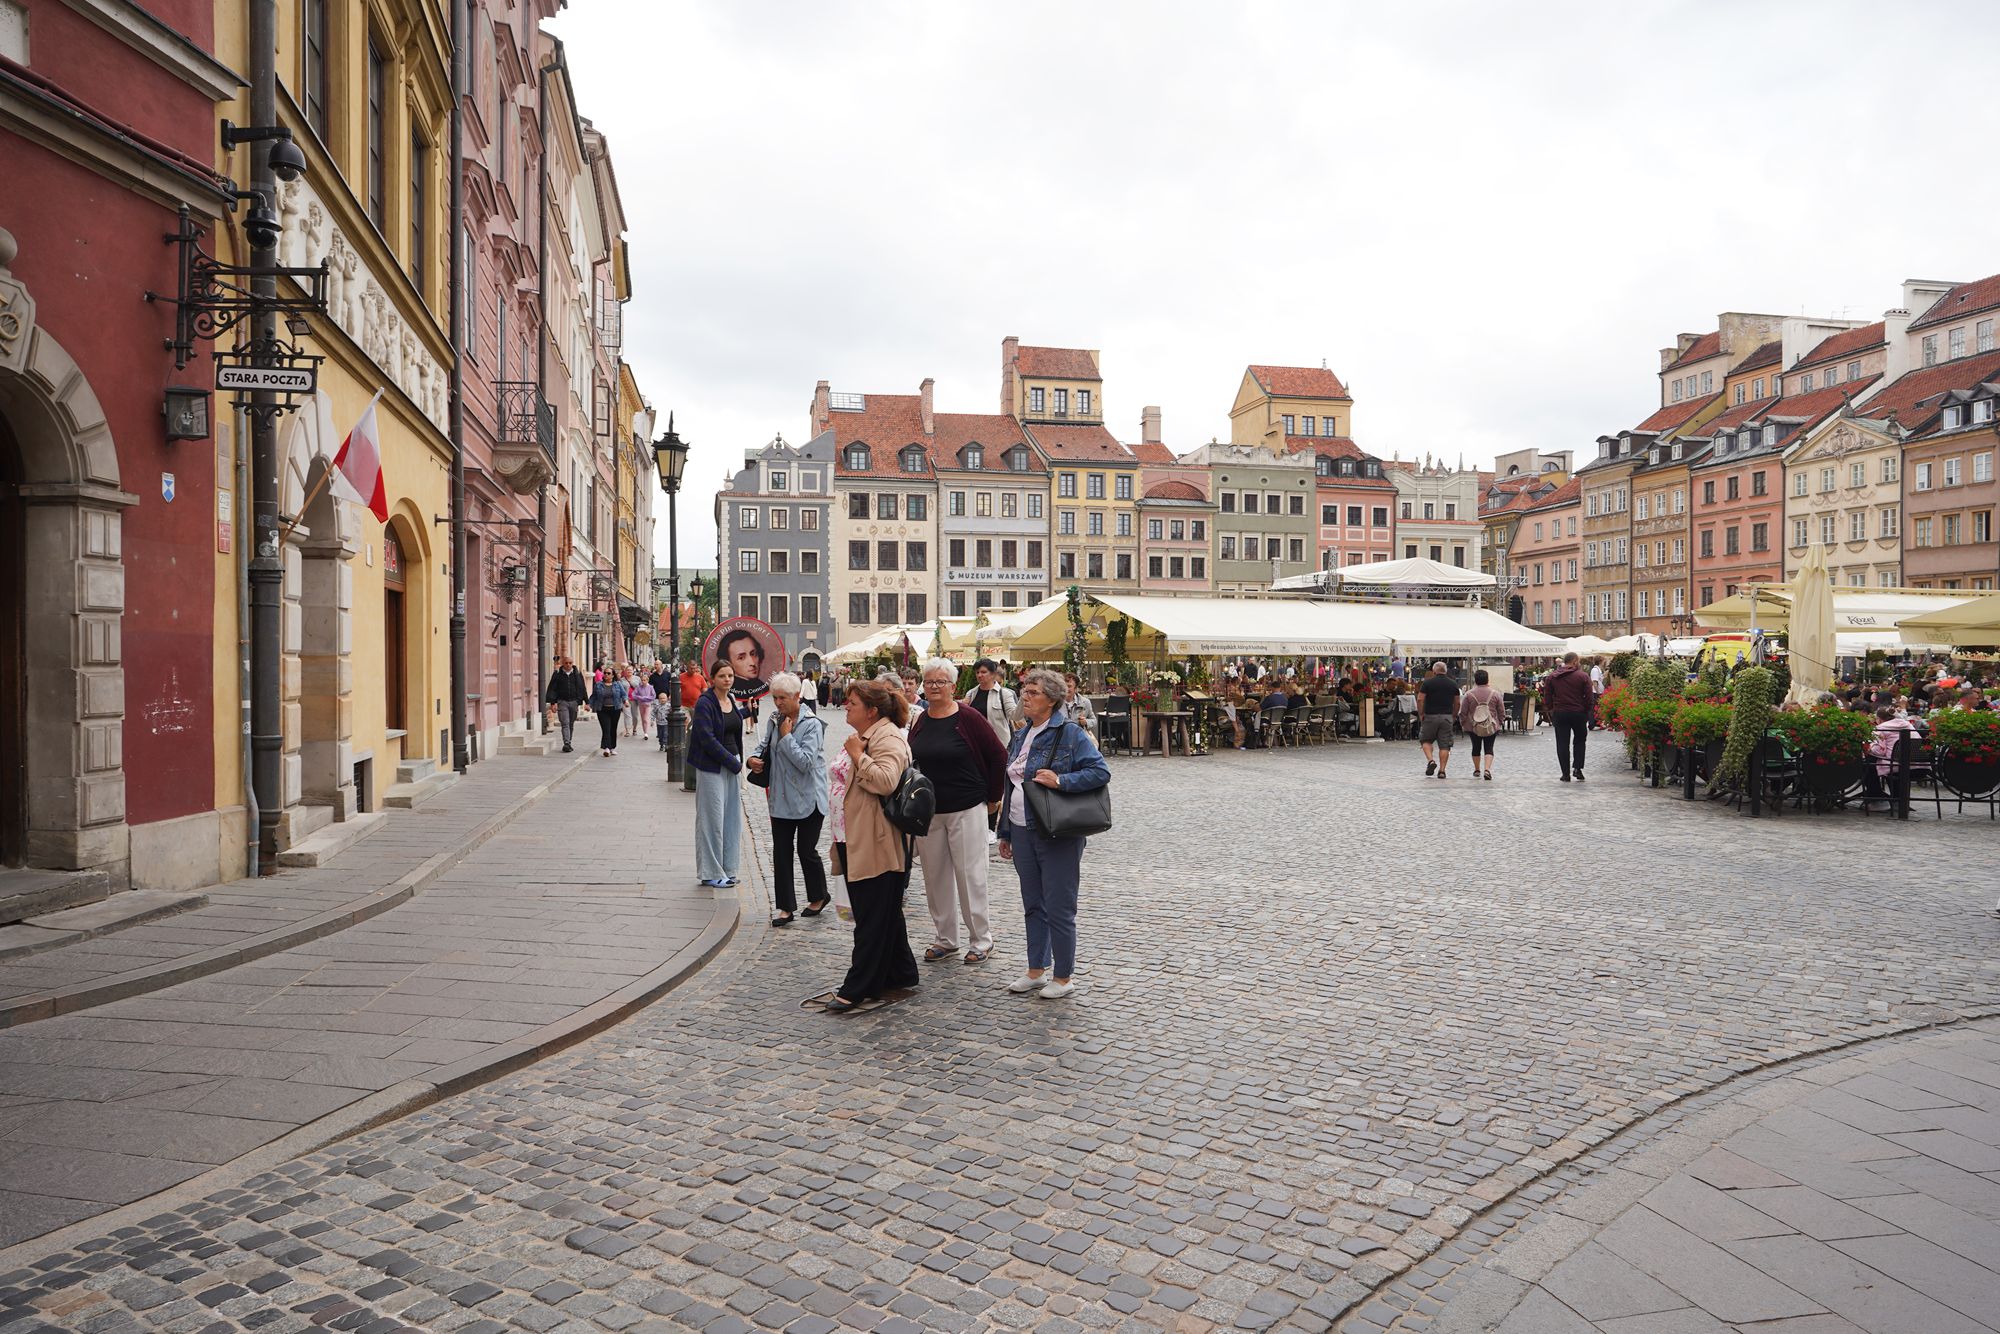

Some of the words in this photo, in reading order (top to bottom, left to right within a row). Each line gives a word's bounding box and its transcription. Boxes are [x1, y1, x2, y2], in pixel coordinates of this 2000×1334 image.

[223, 372, 260, 384] STARA
[262, 373, 307, 386] POCZTA
[958, 571, 992, 579] MUZEUM
[1847, 615, 1876, 625] Kozel
